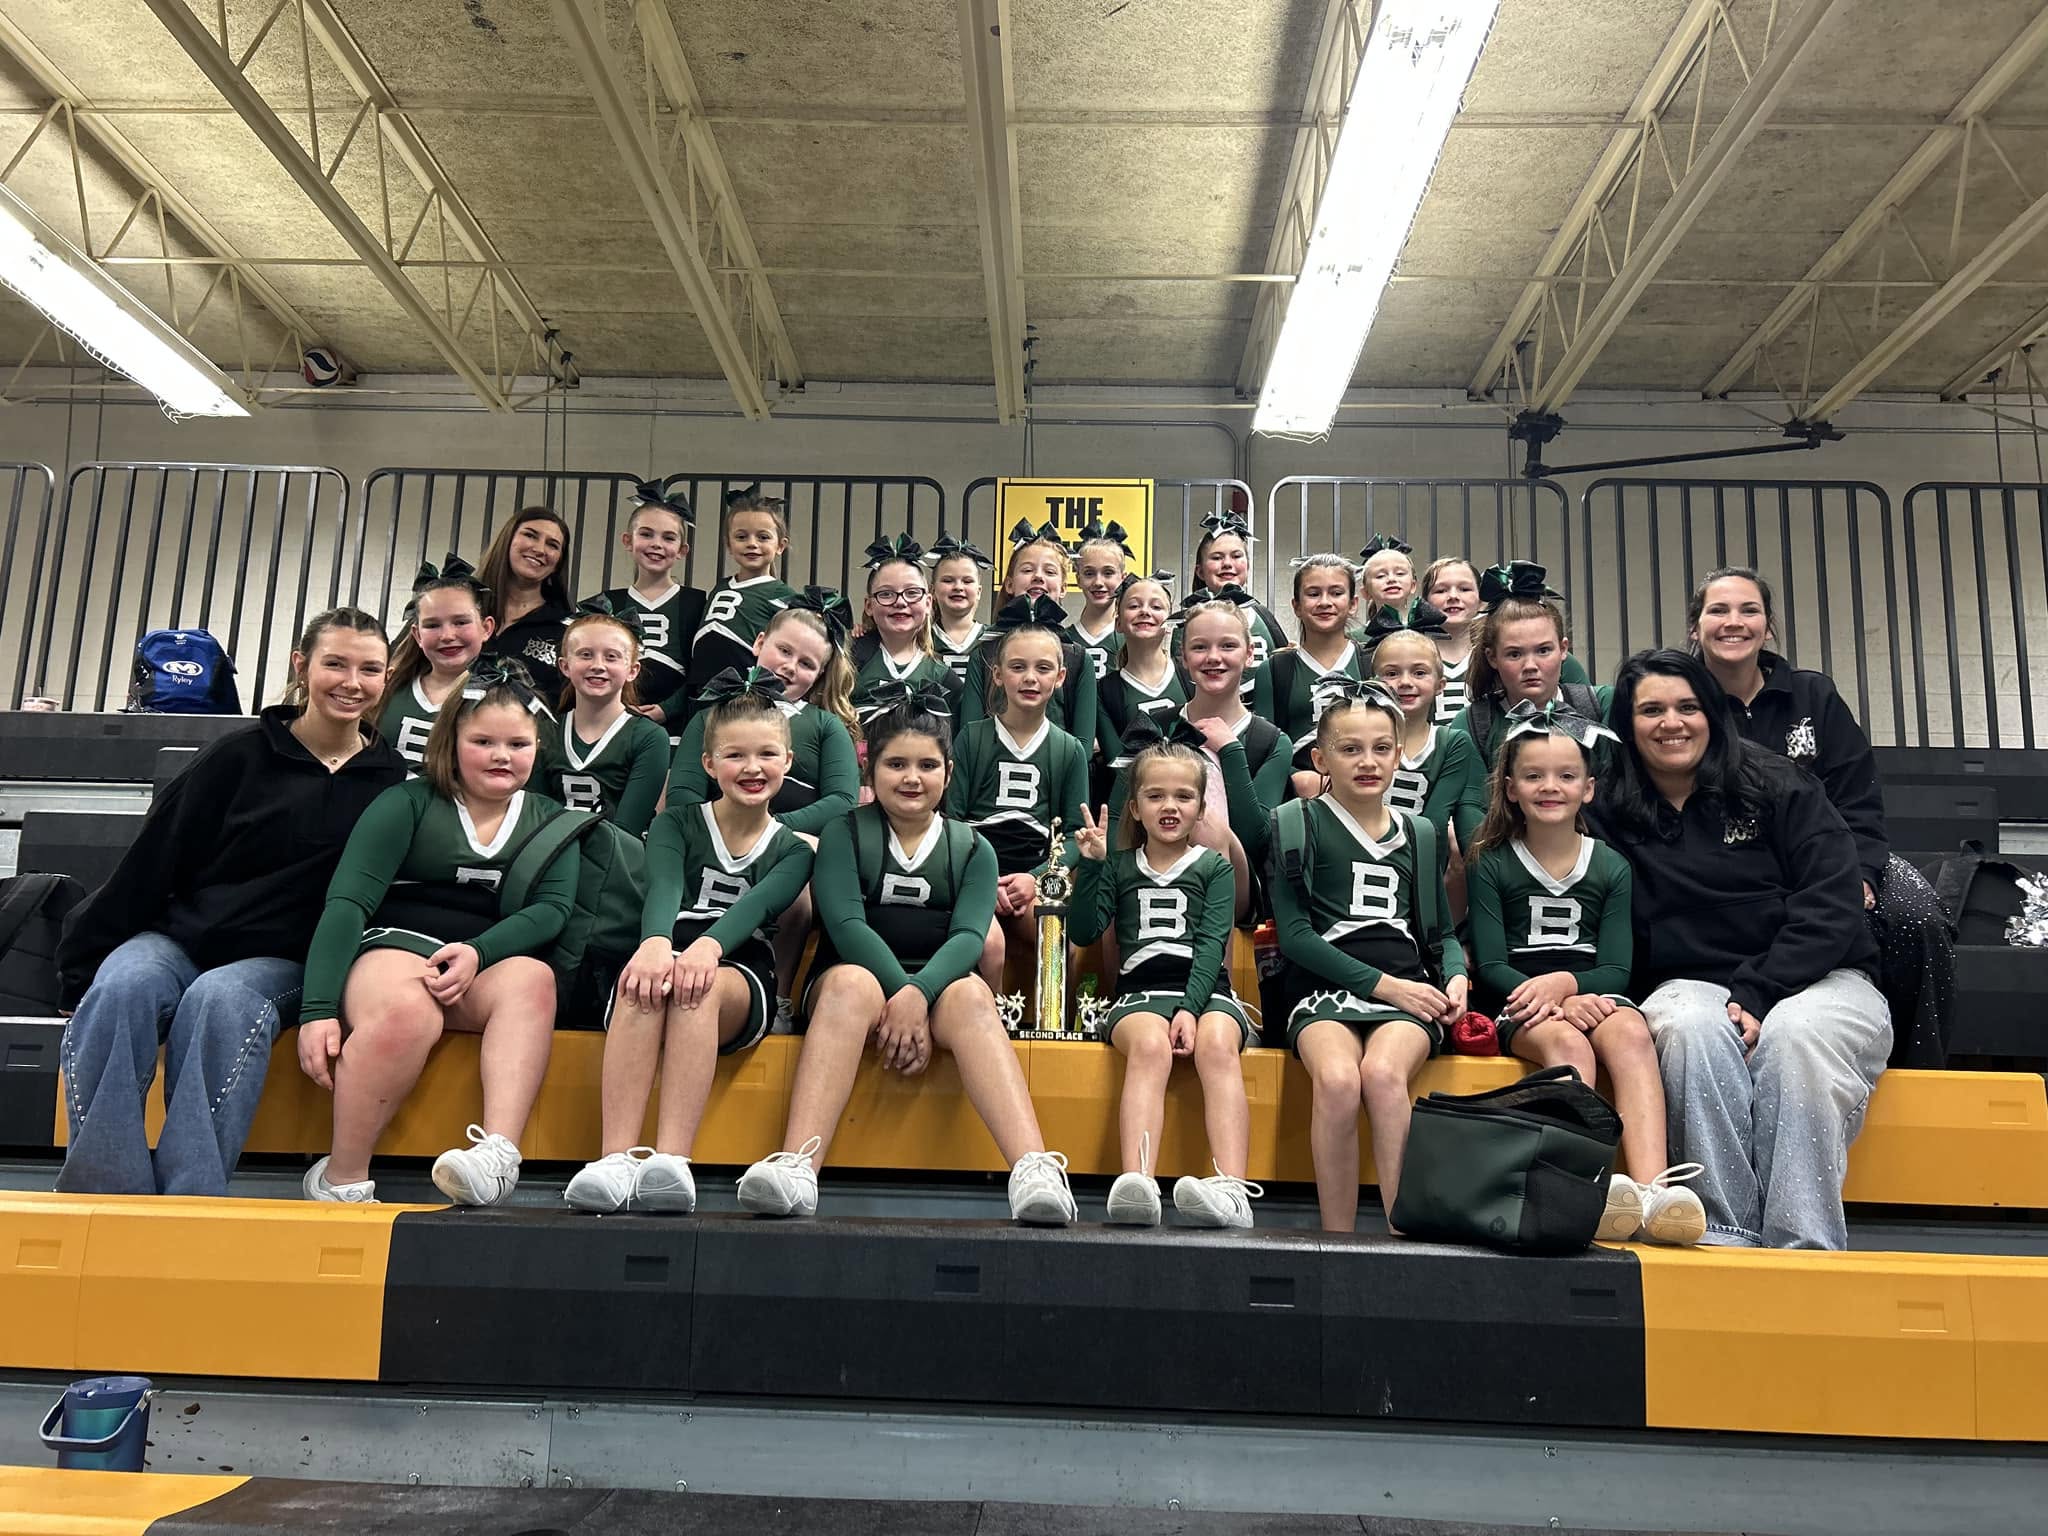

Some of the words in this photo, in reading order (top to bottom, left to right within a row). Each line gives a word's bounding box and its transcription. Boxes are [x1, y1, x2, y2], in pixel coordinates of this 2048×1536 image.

[1046, 497, 1104, 529] THE
[705, 590, 743, 621] B
[638, 613, 670, 647] B
[996, 761, 1041, 809] B
[1382, 769, 1429, 815] B
[1350, 861, 1400, 919] B
[1137, 888, 1188, 940] B
[1528, 896, 1582, 946] B
[1019, 1030, 1054, 1040] SECOND
[1055, 1031, 1083, 1041] PLACE
